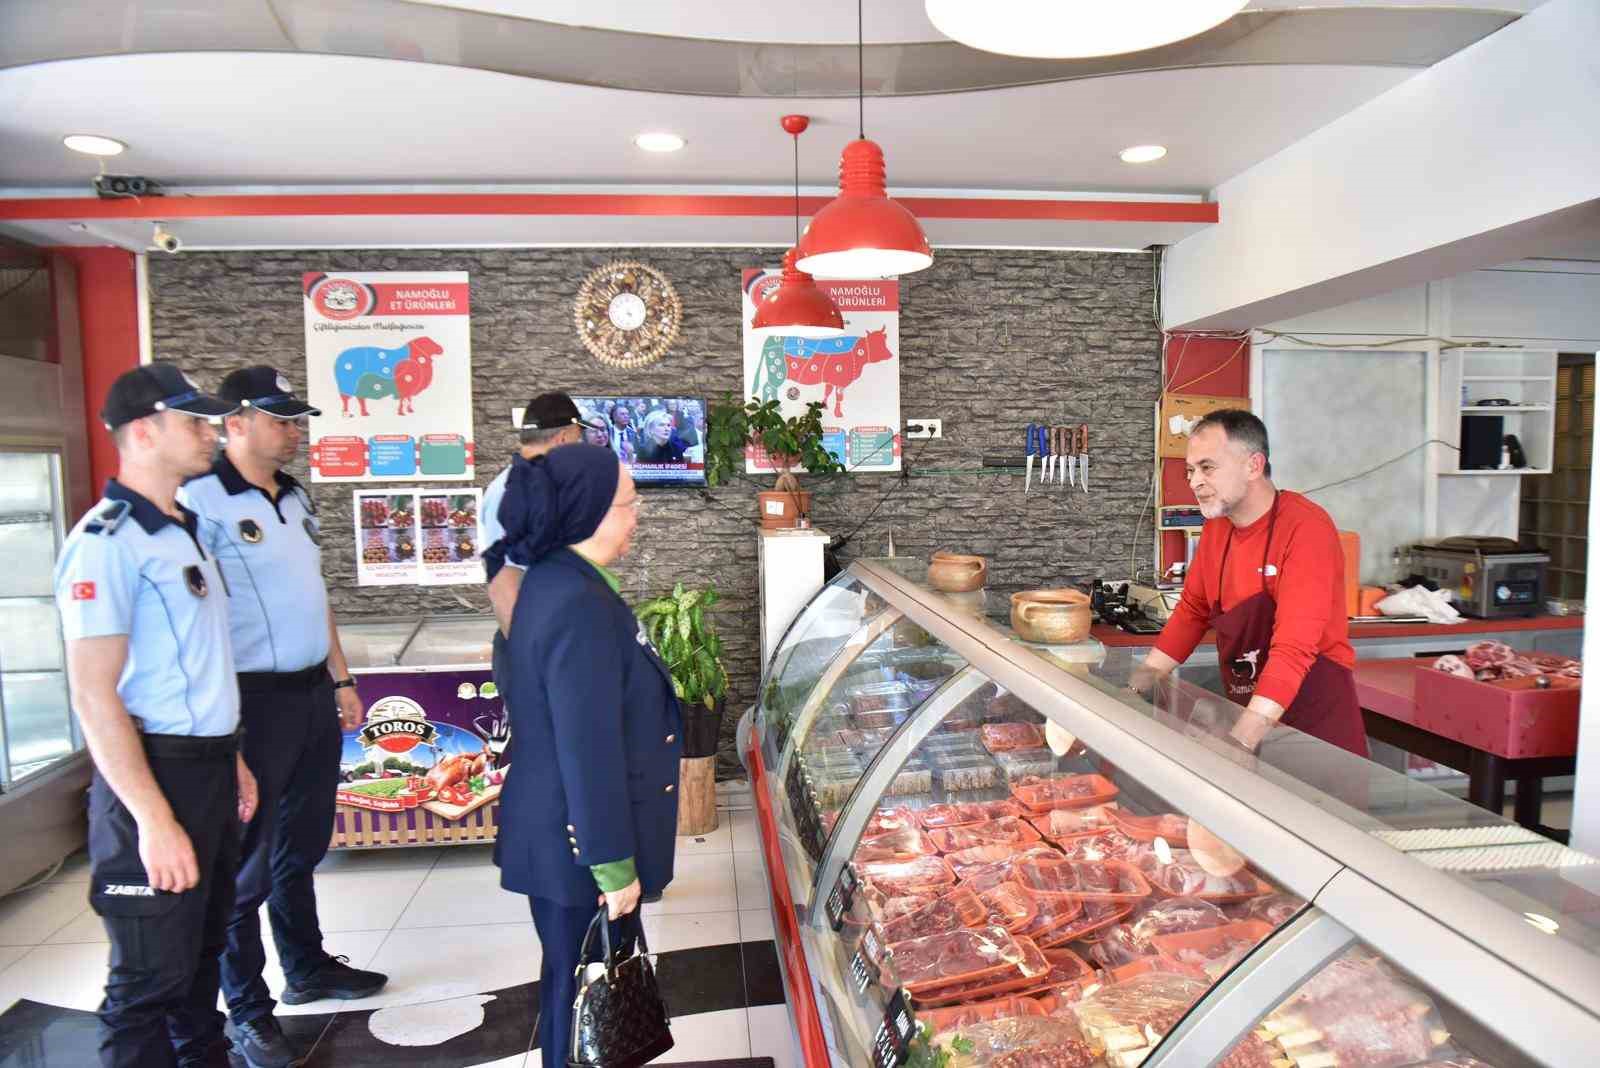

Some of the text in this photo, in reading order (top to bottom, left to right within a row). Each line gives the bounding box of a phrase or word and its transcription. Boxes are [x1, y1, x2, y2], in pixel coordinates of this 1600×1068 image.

[395, 287, 449, 299] NAMOĞLU
[830, 284, 880, 296] NAMOĞLU
[390, 299, 456, 310] ET ÜRÜNLERİ
[838, 296, 886, 306] ÜRÜNLERİ
[370, 721, 425, 737] TOROS
[104, 884, 155, 896] ZABITA
